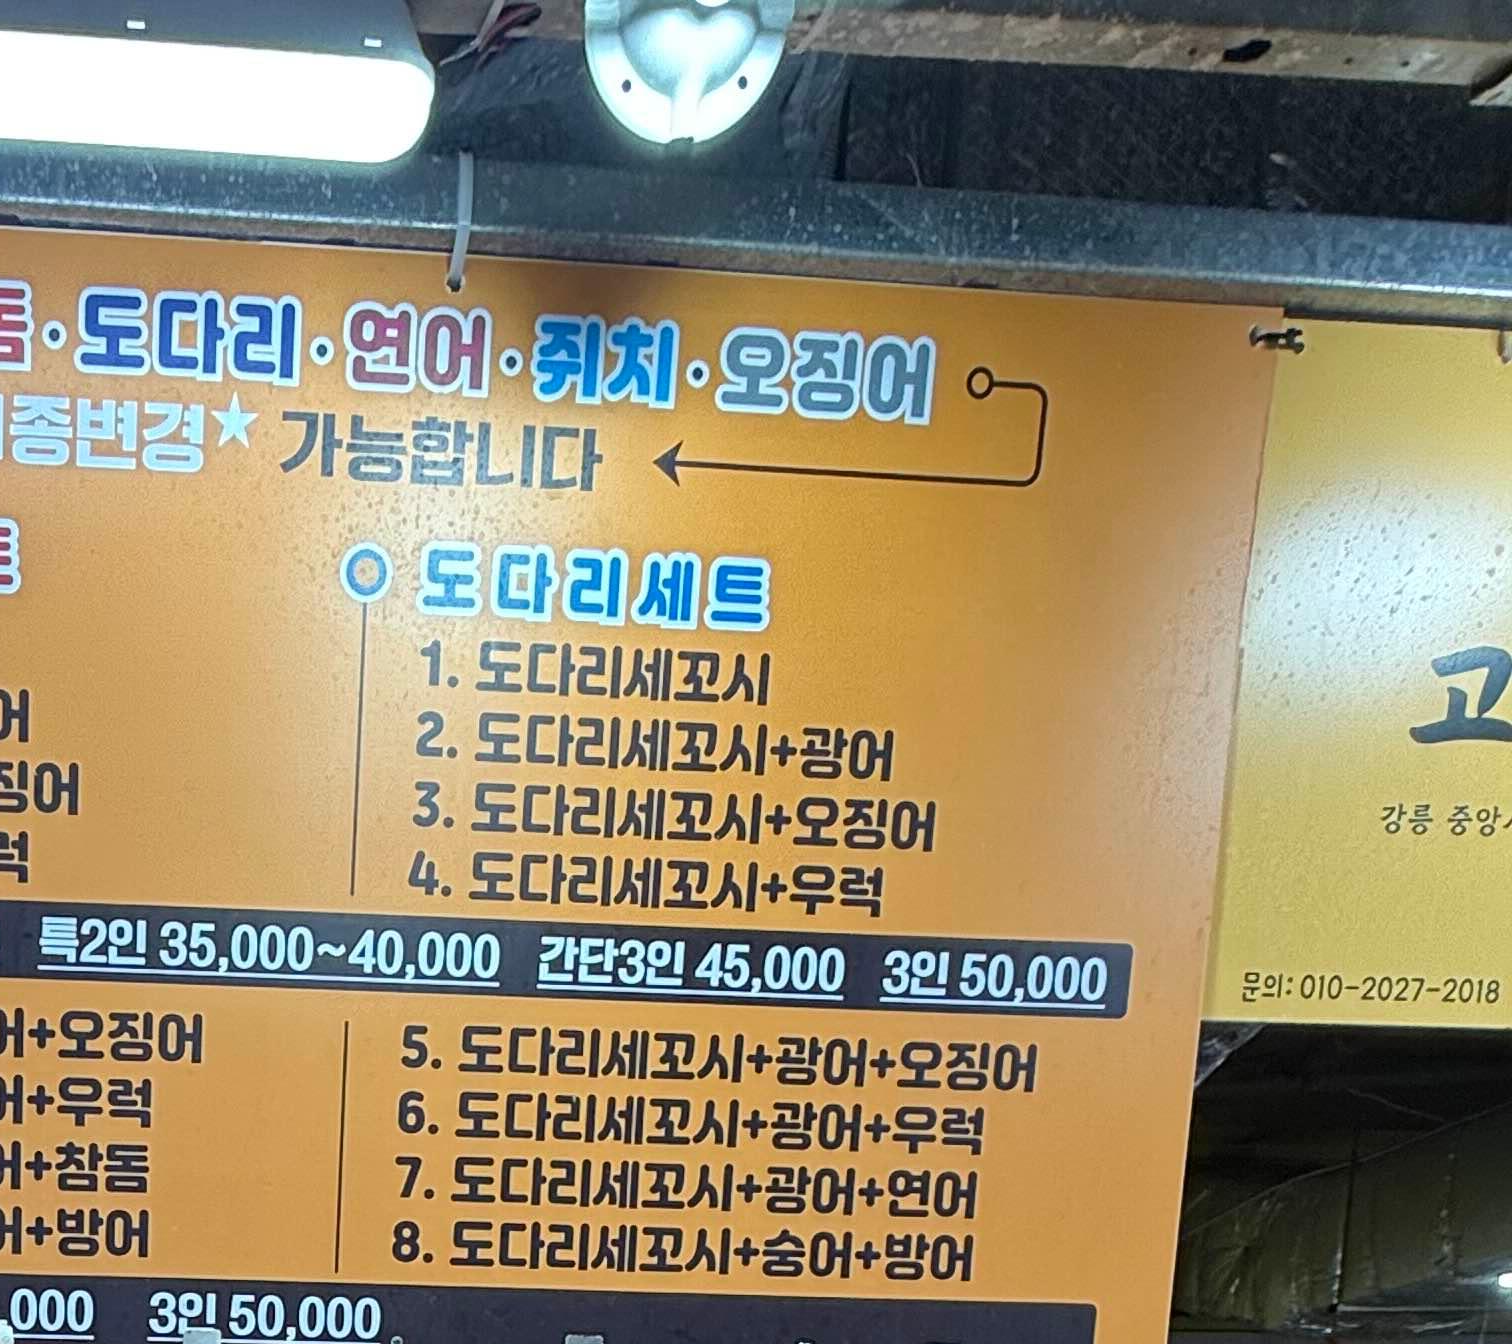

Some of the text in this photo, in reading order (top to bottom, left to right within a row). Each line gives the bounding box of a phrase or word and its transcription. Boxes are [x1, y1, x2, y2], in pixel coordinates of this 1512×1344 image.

[279, 408, 604, 492] 가능합니다
[415, 542, 772, 629] 도다리세트
[474, 639, 772, 708] 도다리세꼬시
[1380, 803, 1434, 836] 강릉
[38, 914, 147, 965] 특2인
[157, 920, 501, 981] 35,000~40,000
[537, 935, 685, 987] 간단3인
[694, 942, 845, 995] 45,000
[882, 949, 949, 997] 3인
[958, 953, 1108, 1004] 50,000
[1299, 974, 1501, 1004] 010-2027-2018
